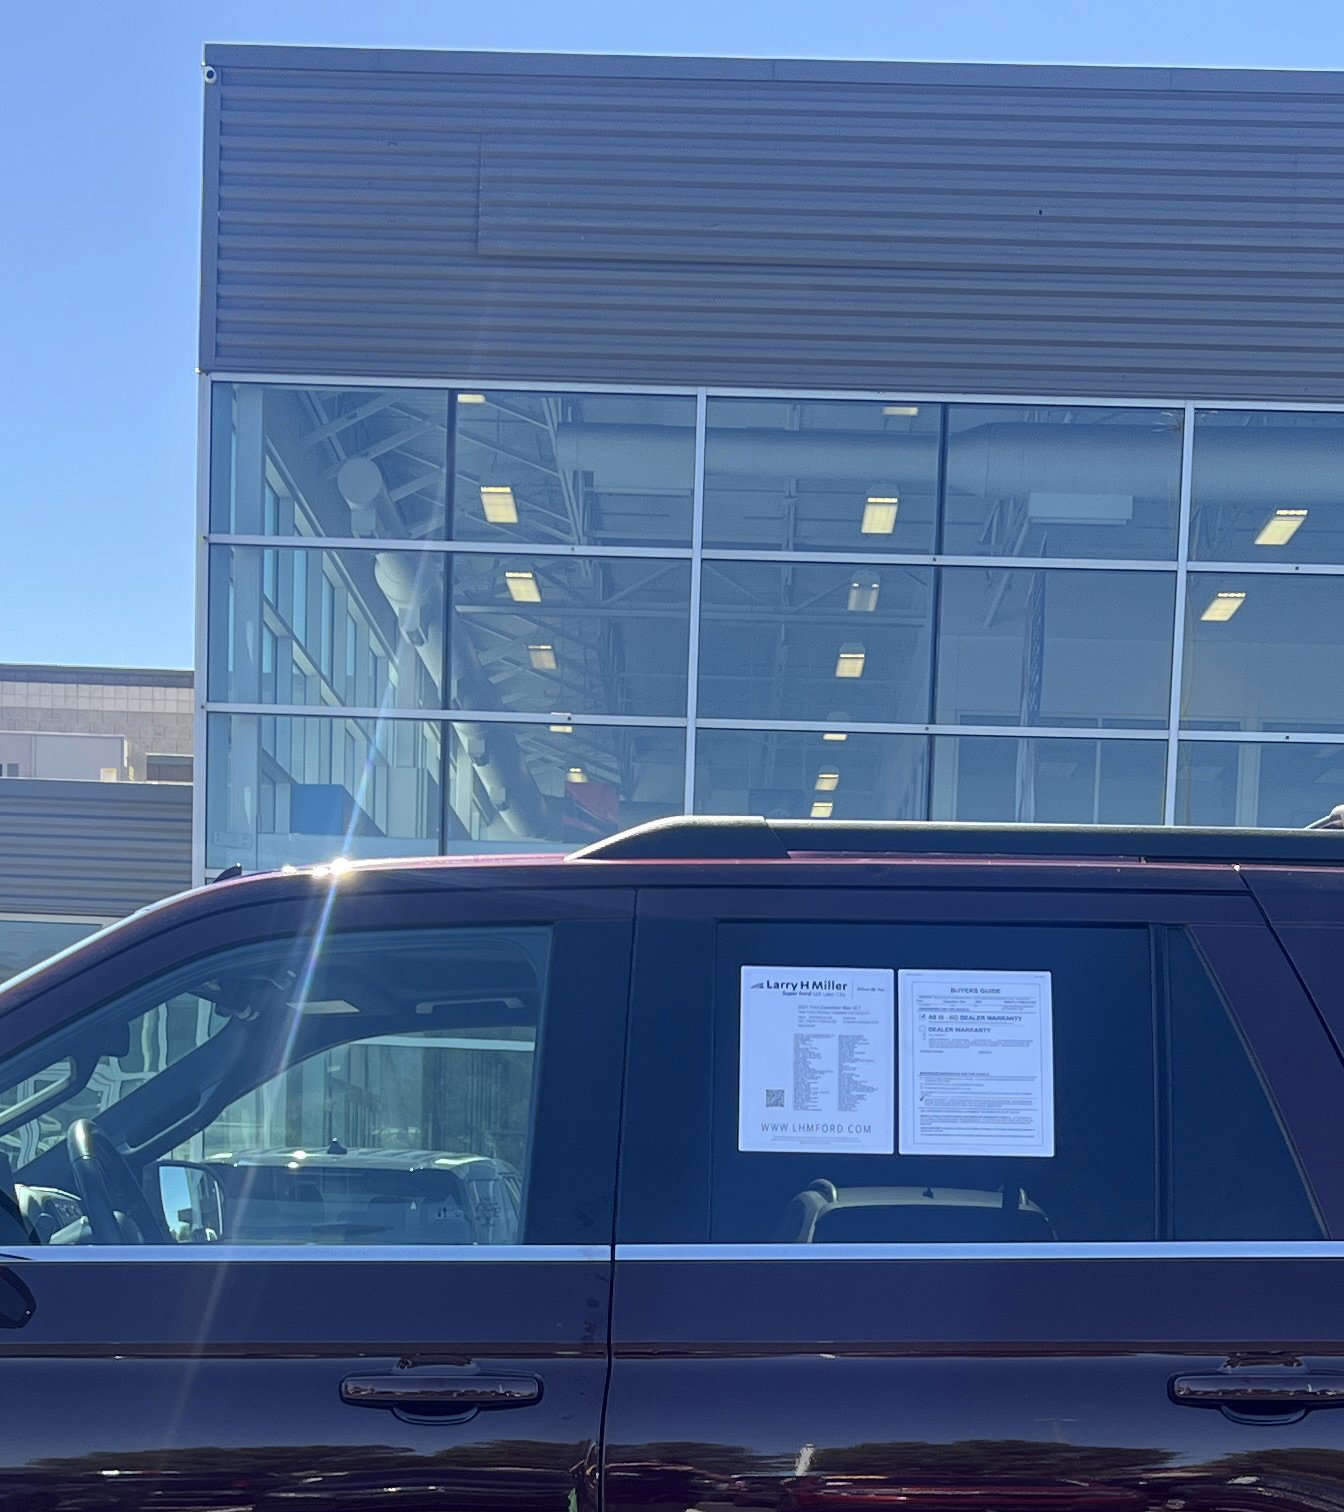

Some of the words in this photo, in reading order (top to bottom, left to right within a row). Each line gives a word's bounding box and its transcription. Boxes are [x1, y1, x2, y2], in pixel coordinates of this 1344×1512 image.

[766, 979, 798, 991] Larry
[800, 980, 810, 990] H
[811, 980, 848, 991] Miller
[836, 991, 846, 999] City
[760, 1122, 872, 1134] WWW.LHMFORDCOM
